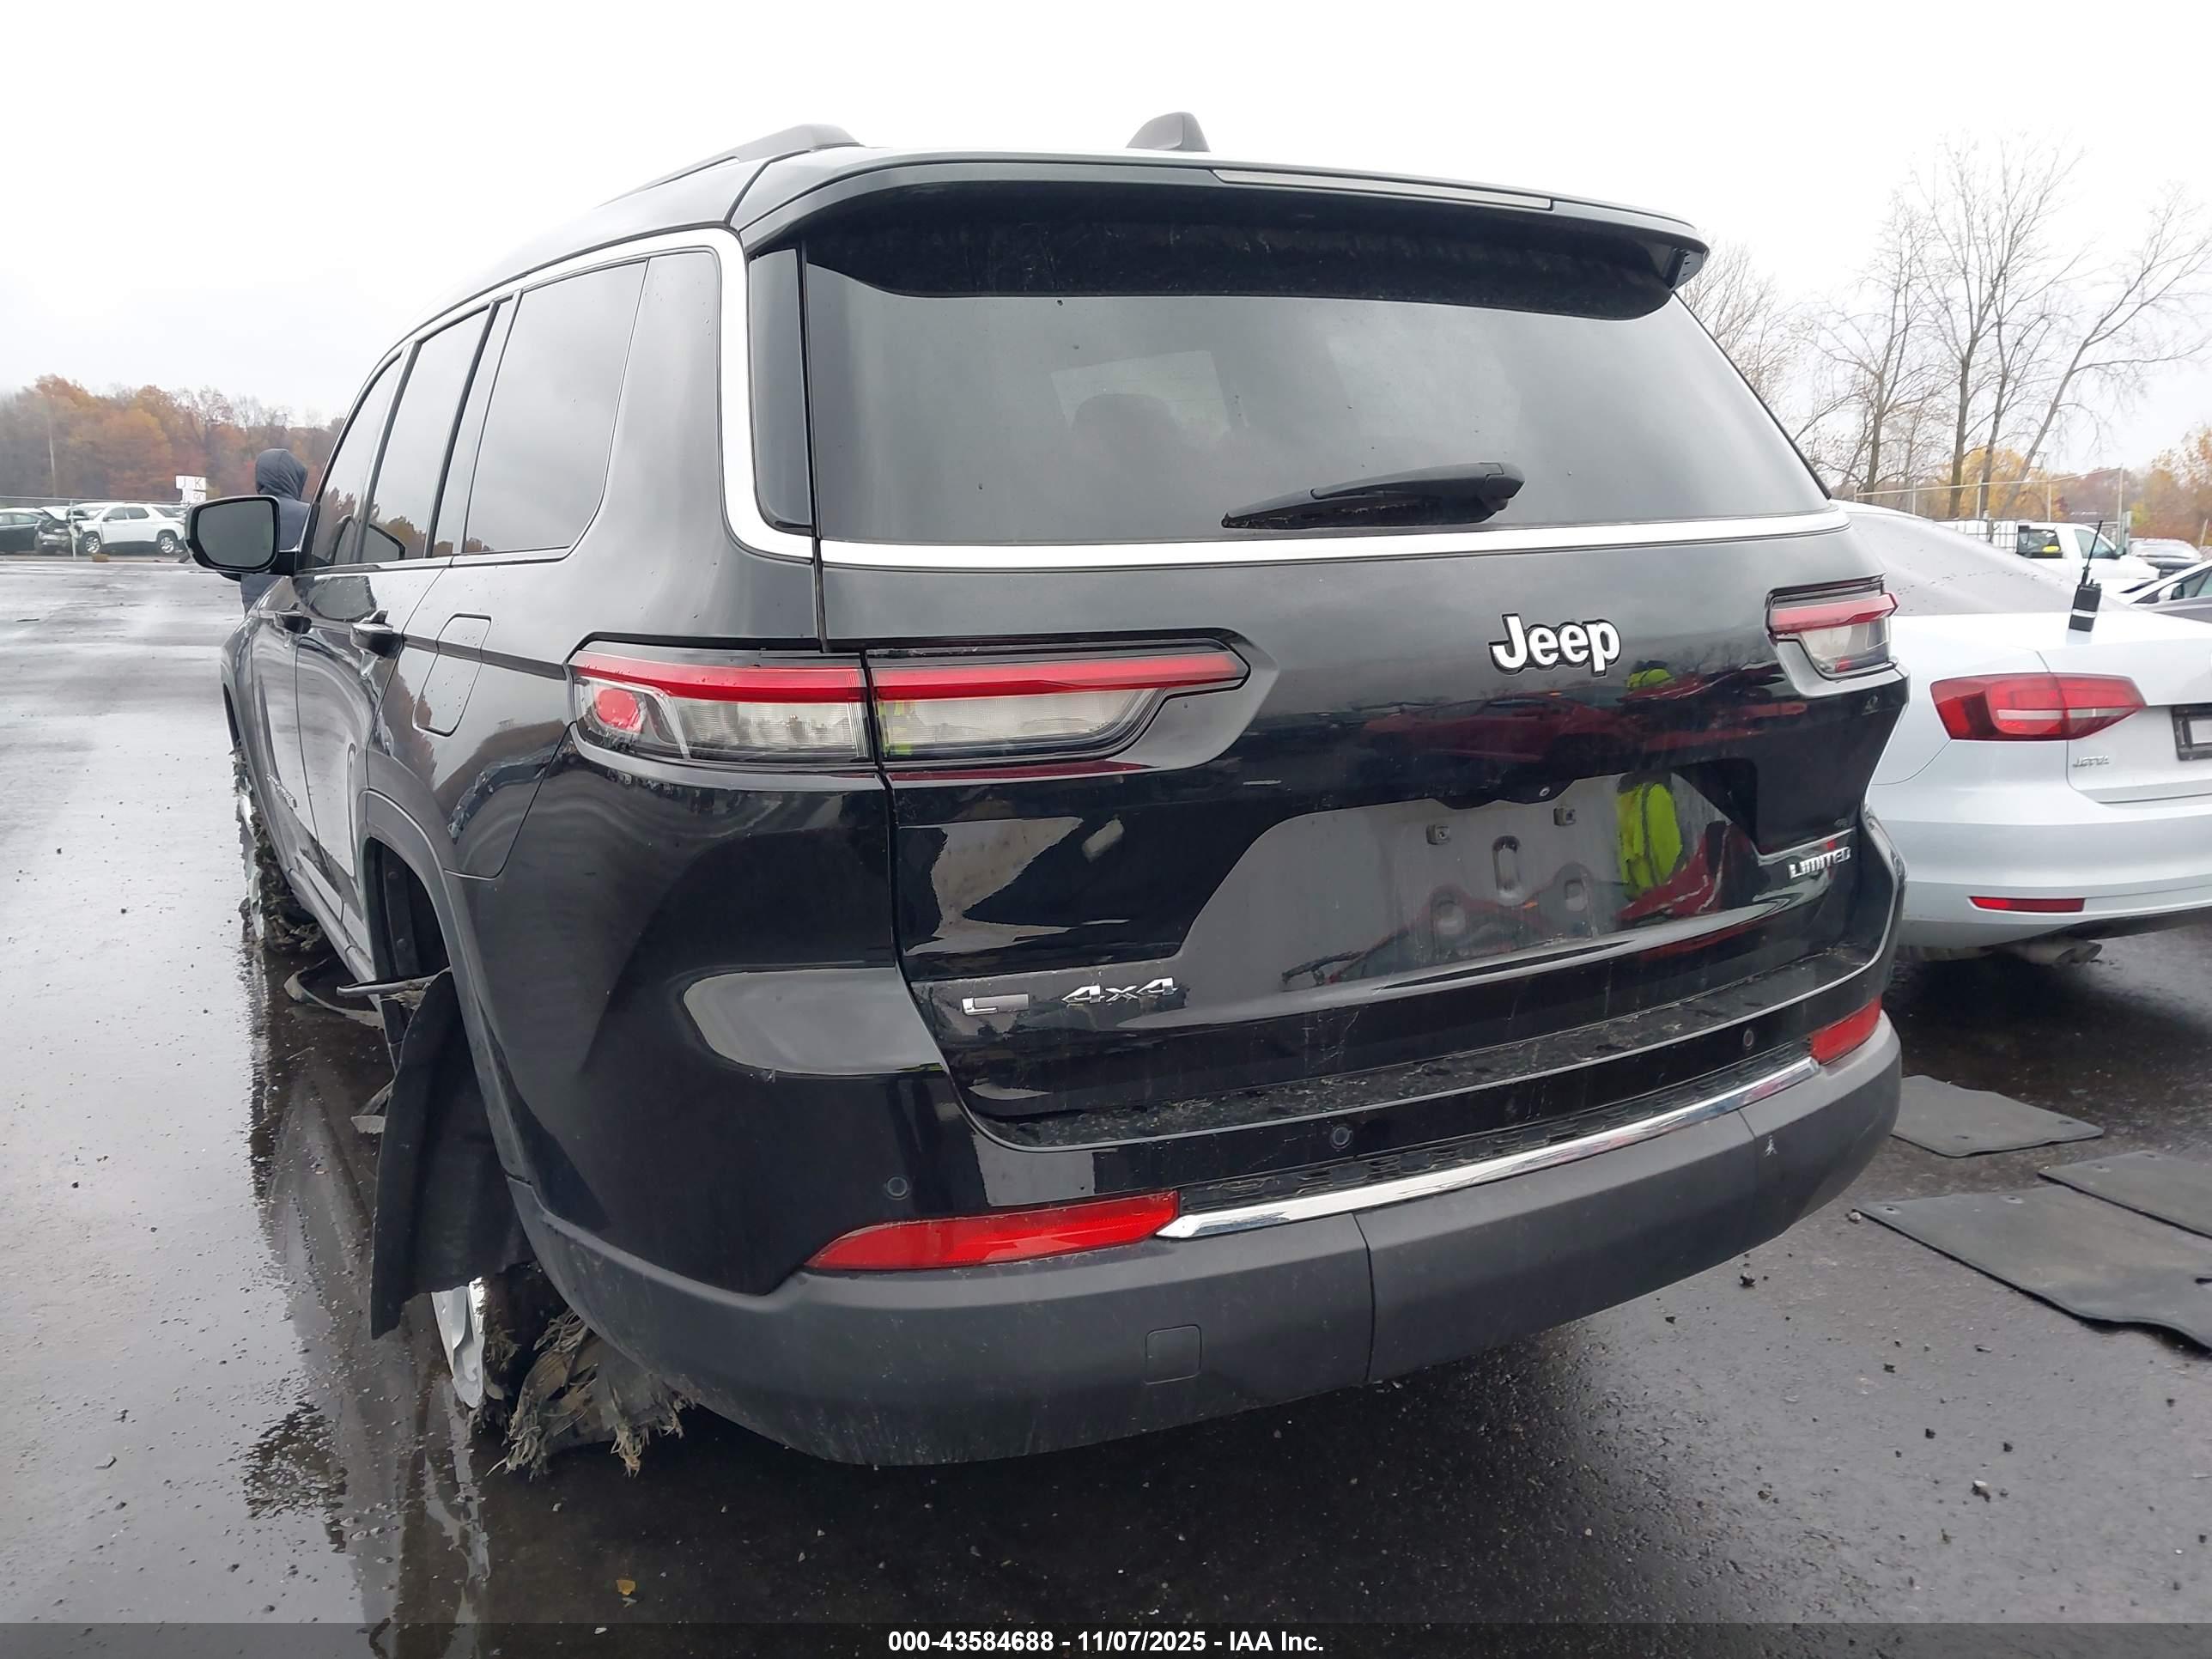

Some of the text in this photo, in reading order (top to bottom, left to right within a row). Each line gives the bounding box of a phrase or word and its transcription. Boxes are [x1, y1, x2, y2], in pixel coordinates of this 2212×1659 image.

[194, 477, 203, 489] K
[1488, 613, 1620, 678] Jeep
[1789, 846, 1851, 879] LIMITED
[1061, 977, 1177, 1004] 4x4
